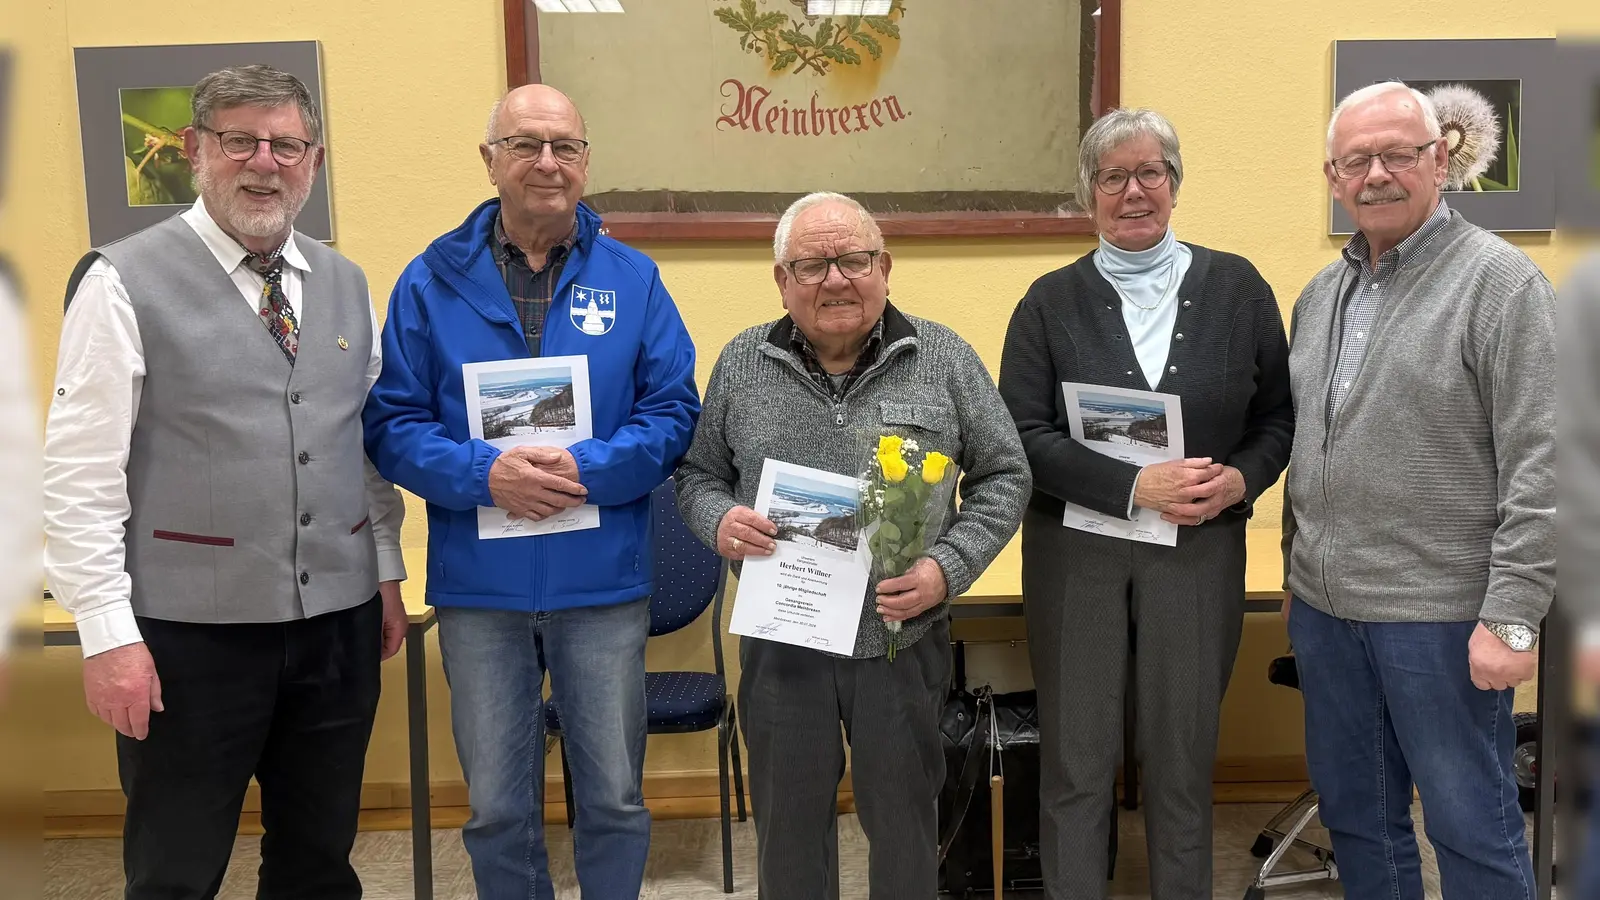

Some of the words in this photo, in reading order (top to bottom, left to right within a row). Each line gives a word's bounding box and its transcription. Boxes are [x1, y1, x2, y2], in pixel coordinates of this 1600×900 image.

[716, 78, 912, 136] Meinbrexen.
[780, 561, 805, 572] Herbert
[808, 567, 832, 578] Willner
[798, 587, 827, 597] Mitgliedschaft
[775, 600, 796, 608] Concordia
[784, 597, 813, 607] Gesangverein
